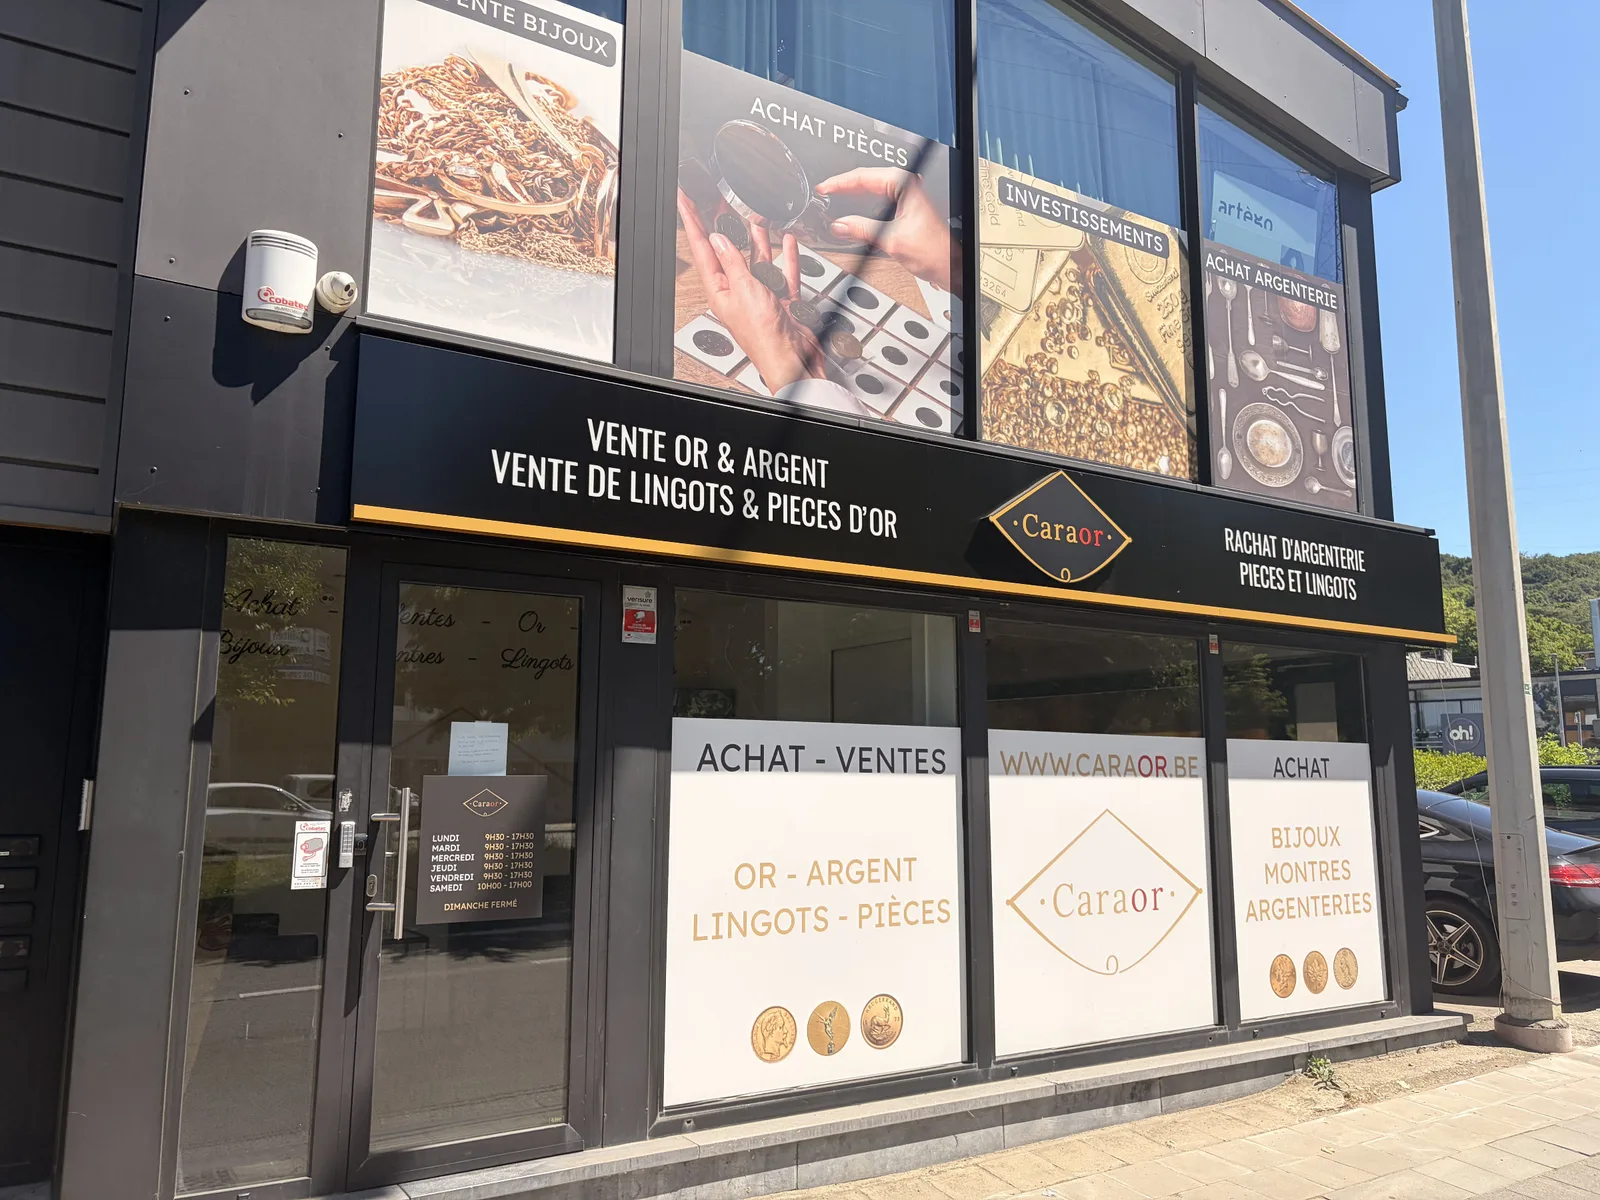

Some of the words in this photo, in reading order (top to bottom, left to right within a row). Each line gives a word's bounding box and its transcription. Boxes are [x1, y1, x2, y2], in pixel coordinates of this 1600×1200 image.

[524, 11, 609, 58] BIJOUX
[750, 97, 826, 137] ACHAT
[833, 128, 908, 167] PIÈCES
[1006, 183, 1163, 252] INVESTISSEMENTS
[1206, 253, 1251, 281] ACHAT
[1255, 266, 1338, 309] ARGENTERIE
[587, 418, 666, 463] VENTE
[675, 434, 708, 469] OR
[717, 442, 735, 474] &
[743, 447, 829, 488] ARGENT
[491, 449, 578, 495] VENTE
[588, 464, 621, 500] DE
[630, 470, 734, 516] LINGOTS
[742, 488, 760, 520] &
[768, 492, 841, 532] PIECES
[849, 504, 898, 539] D'OR
[1022, 513, 1104, 547] Caraor
[1224, 527, 1277, 559] RACHAT
[1282, 538, 1366, 573] D'ARGENTERIE
[1239, 562, 1286, 592] PIECES
[1288, 569, 1302, 594] ET
[1305, 572, 1357, 601] LINGOTS
[223, 588, 301, 617] Achat
[627, 596, 653, 604] verisure
[518, 610, 546, 634] Or
[219, 629, 290, 664] Bijoux
[396, 647, 445, 666] ntres
[501, 648, 574, 680] Lingots
[1450, 725, 1474, 740] oh!
[696, 743, 806, 773] ACHAT
[836, 746, 947, 775] VENTES
[1000, 750, 1199, 778] WWW.CARAOR.BE
[1273, 756, 1330, 779] ACHAT
[472, 800, 499, 808] Caraor
[432, 834, 460, 842] LUNDI
[485, 833, 505, 841] 9H30
[511, 832, 534, 840] 17H30
[432, 844, 460, 852] MARDI
[511, 842, 534, 850] 17H30
[1271, 826, 1341, 849] BIJOUX
[430, 864, 457, 872] JEUDI
[484, 862, 503, 870] 9H30
[431, 854, 475, 862] MERCREDI
[511, 852, 533, 860] 17H30
[1265, 859, 1351, 885] MONTRES
[430, 874, 474, 882] VENDREDI
[483, 872, 503, 880] 9H30
[430, 884, 462, 892] SAMEDI
[478, 882, 502, 890] 10H00
[734, 861, 777, 890] OR
[806, 857, 918, 887] ARGENT
[444, 901, 489, 911] DIMANCHE
[491, 899, 518, 909] FERMÉ
[1053, 883, 1163, 918] Caraor
[1245, 892, 1372, 923] ARGENTERIES
[692, 905, 829, 942] LINGOTS
[857, 894, 951, 929] PIÈCES
